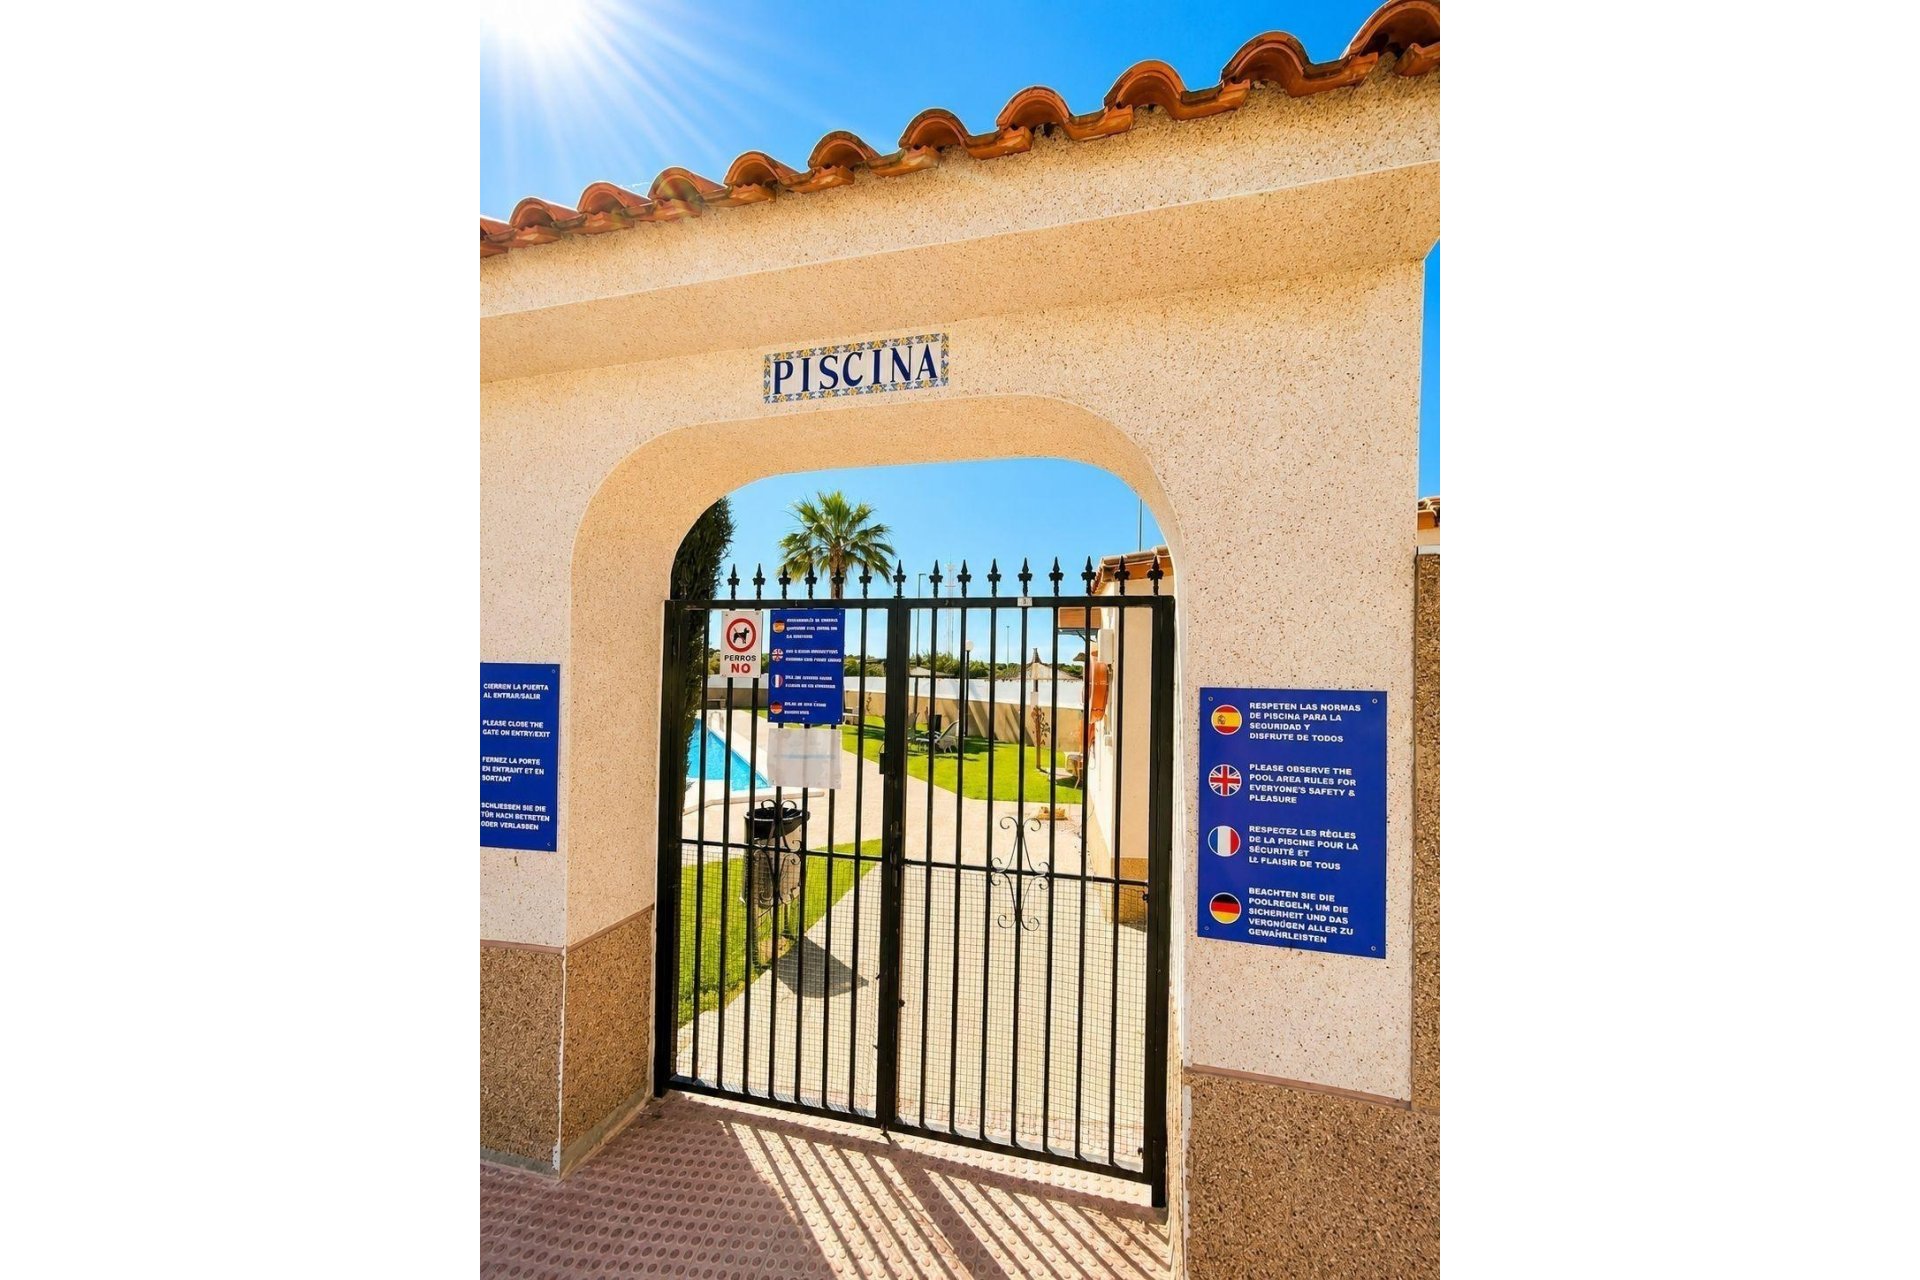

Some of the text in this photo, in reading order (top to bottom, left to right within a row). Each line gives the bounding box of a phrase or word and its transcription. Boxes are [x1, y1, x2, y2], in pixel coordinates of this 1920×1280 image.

[773, 344, 938, 394] PISCINA
[731, 664, 750, 673] NO
[1250, 702, 1297, 710] RESPETEN
[1321, 704, 1361, 712] NORMAS
[1250, 722, 1301, 731] SEGURIDAD
[1250, 733, 1294, 741] DISFRUTE
[1250, 764, 1283, 772] PLEASE
[1287, 766, 1329, 774] OBSERVE
[1250, 774, 1273, 782] POOL
[1250, 785, 1306, 794] EVERYONE'S
[1309, 787, 1345, 796] SAFETY
[1250, 794, 1297, 803] PLEASURE
[515, 814, 550, 822] BETRETEN
[500, 822, 539, 830] VERLASSEN
[1300, 829, 1317, 837] LES
[1278, 838, 1314, 847] PISCINE
[1318, 840, 1343, 849] POUR
[1346, 842, 1358, 850] LA
[1298, 849, 1309, 857] ET
[1300, 860, 1312, 868] DE
[1315, 862, 1341, 870] TOUS
[1249, 888, 1298, 898] BEACHTEN
[1319, 894, 1335, 902] DIE
[1249, 898, 1313, 911] POOLREGELN,
[1316, 904, 1330, 912] UM
[1249, 908, 1348, 924] SICHERHEIT UND DAS
[1308, 924, 1337, 933] ALLER
